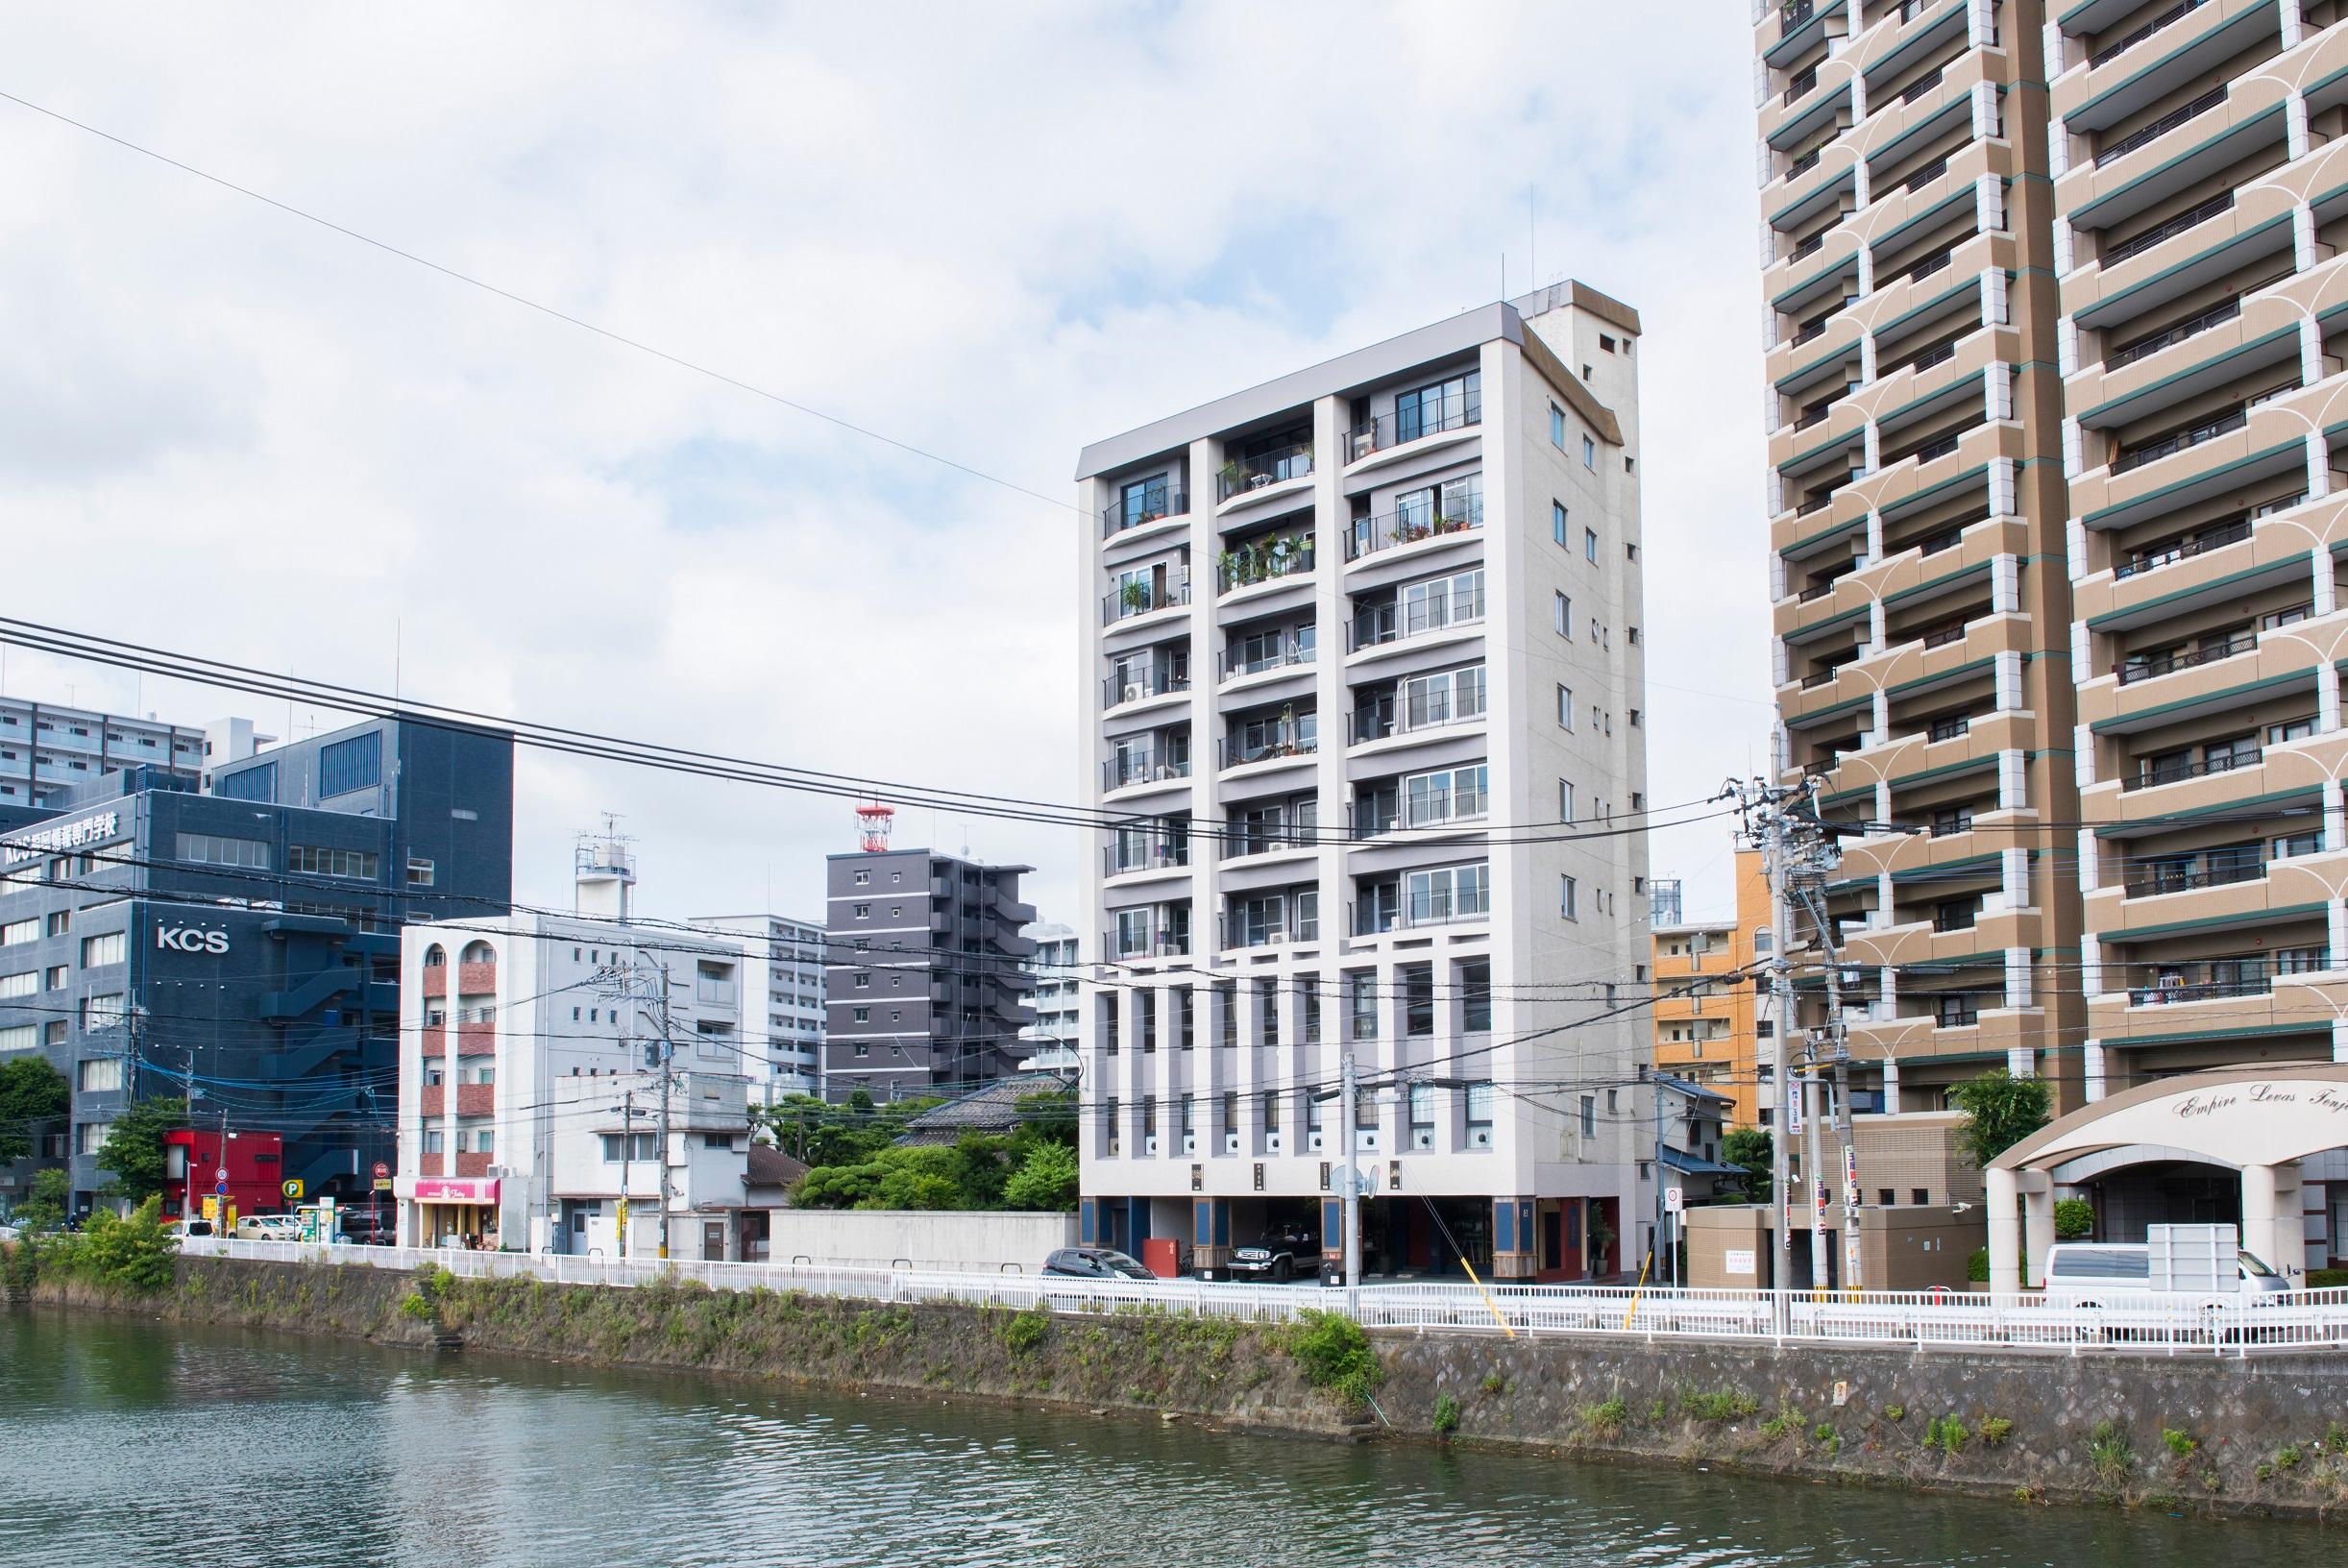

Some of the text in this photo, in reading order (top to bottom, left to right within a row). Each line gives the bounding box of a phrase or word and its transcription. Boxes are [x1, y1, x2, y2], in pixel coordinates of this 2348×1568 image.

[158, 926, 230, 954] KCS
[2172, 1095, 2238, 1118] Empire
[2249, 1084, 2296, 1102] Levas
[288, 1183, 298, 1195] P
